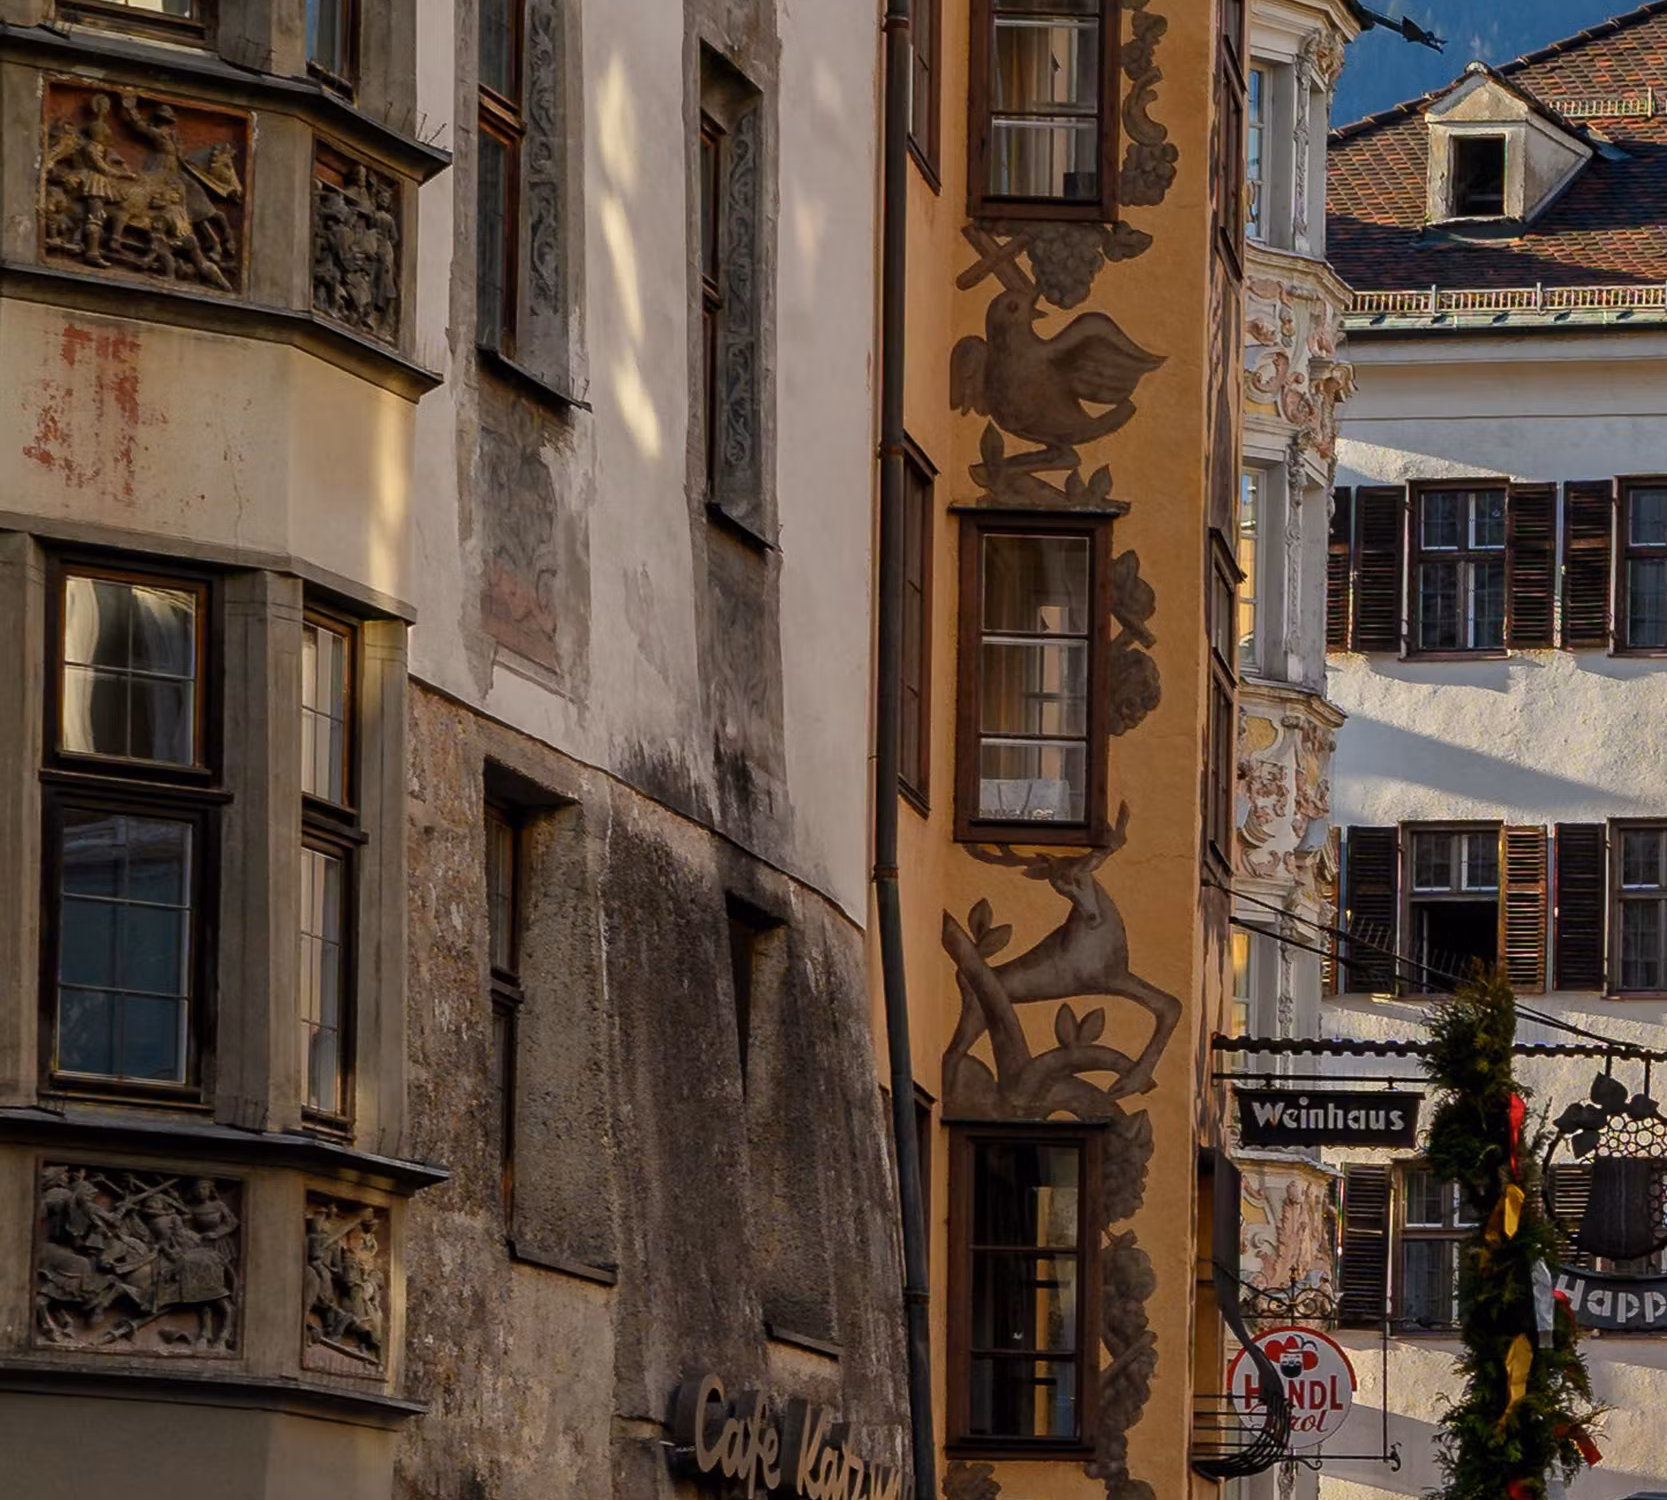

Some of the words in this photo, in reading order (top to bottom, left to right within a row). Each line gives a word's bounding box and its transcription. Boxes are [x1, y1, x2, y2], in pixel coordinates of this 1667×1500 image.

[1252, 1097, 1405, 1131] Weinhaus
[1554, 1274, 1667, 1323] Happ
[1244, 1373, 1343, 1411] HNDL
